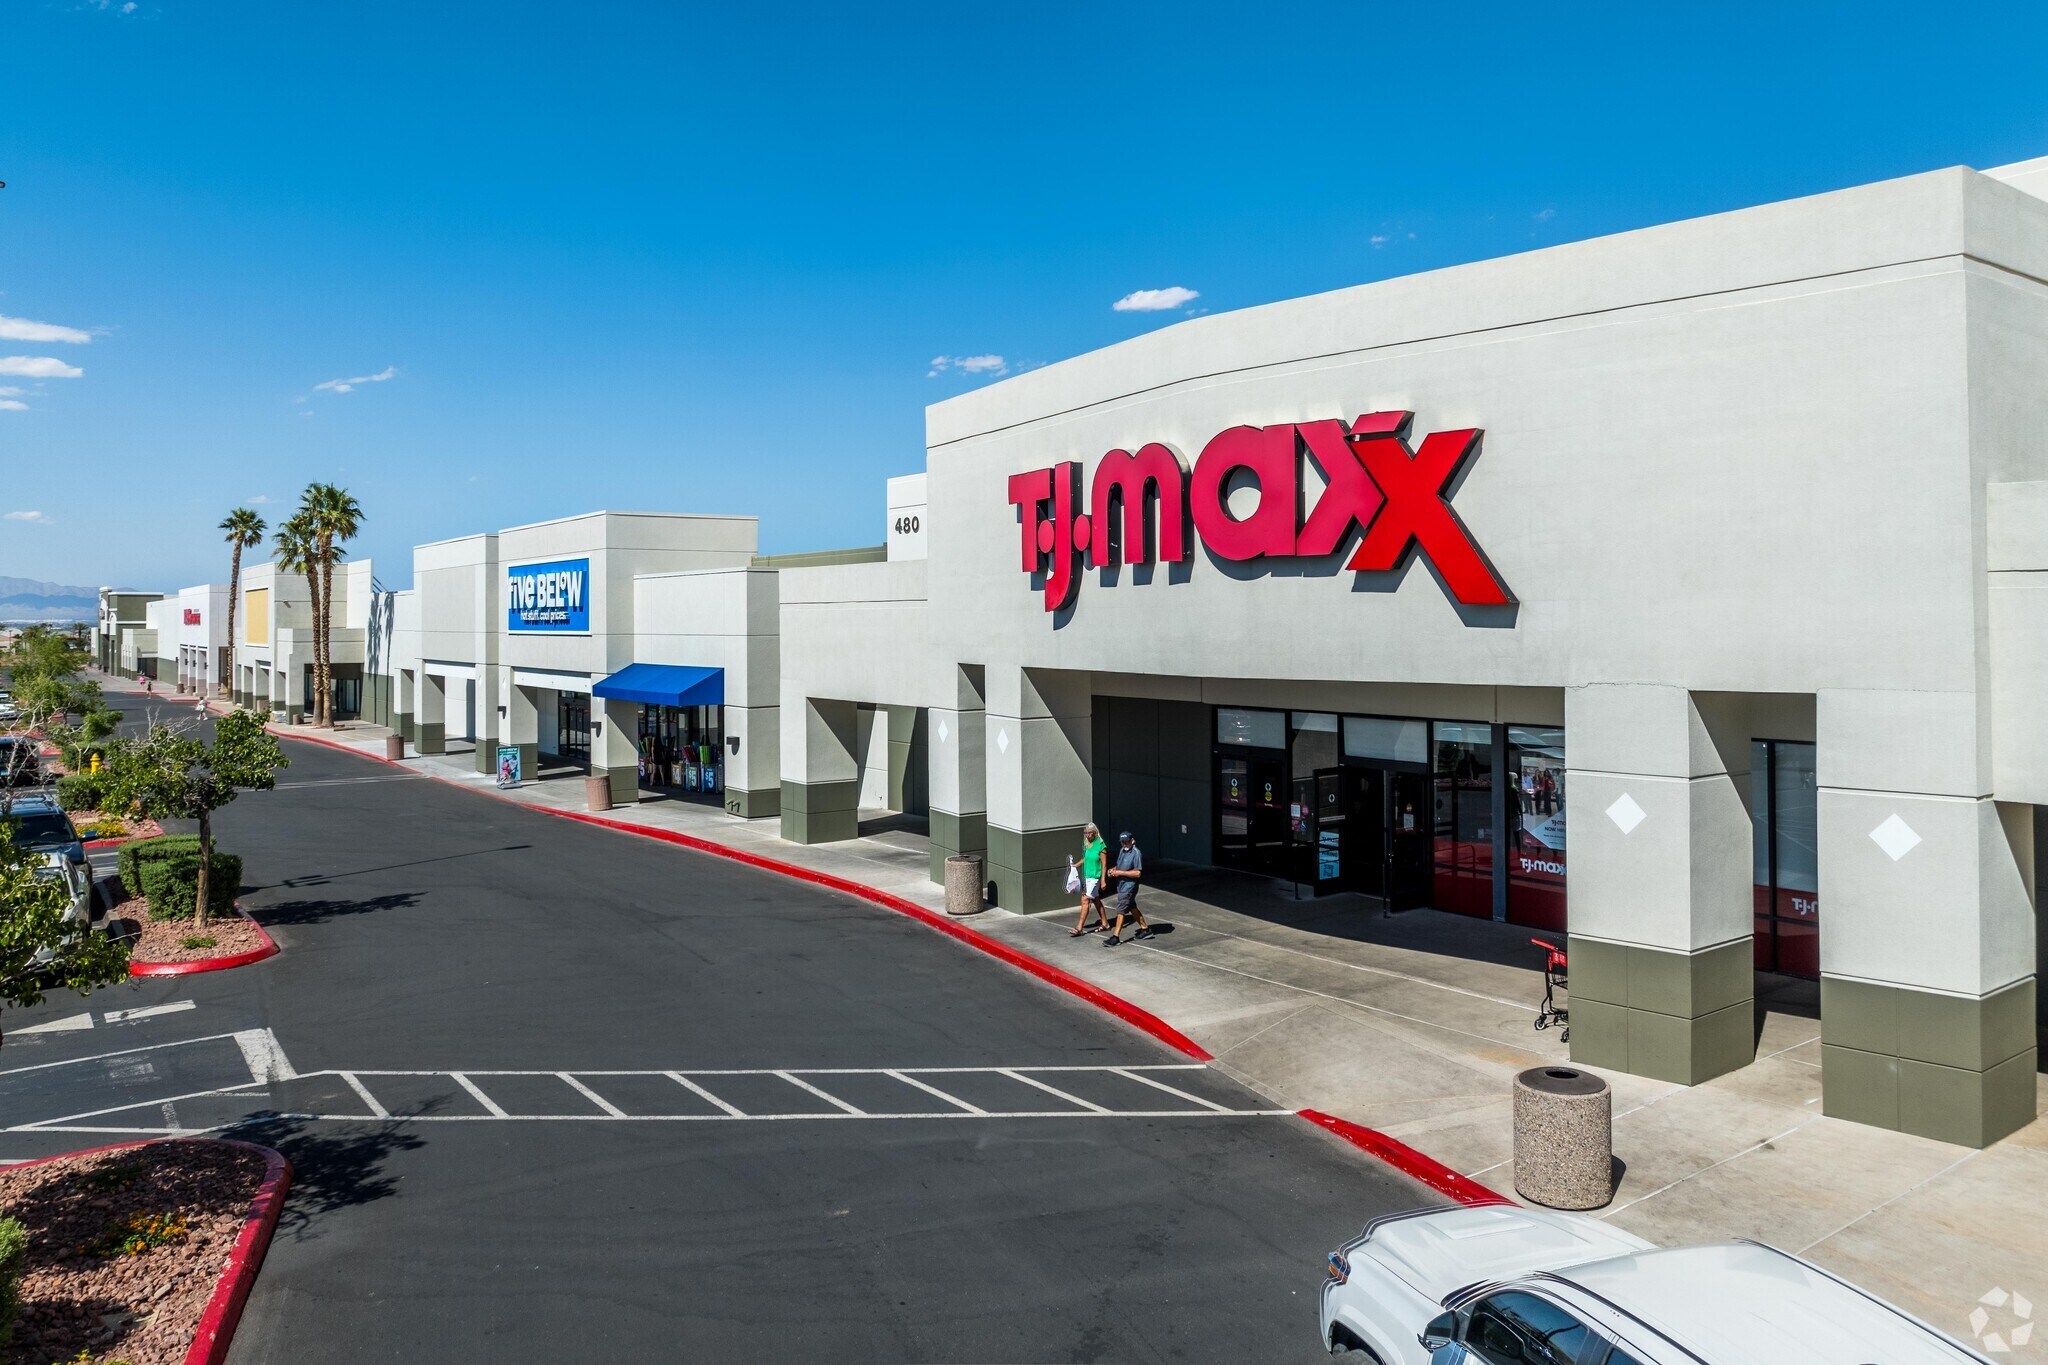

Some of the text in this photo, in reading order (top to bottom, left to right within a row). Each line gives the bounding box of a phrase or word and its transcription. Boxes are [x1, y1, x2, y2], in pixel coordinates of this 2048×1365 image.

[895, 516, 919, 534] 480
[508, 575, 535, 609] five
[705, 771, 714, 788] $5
